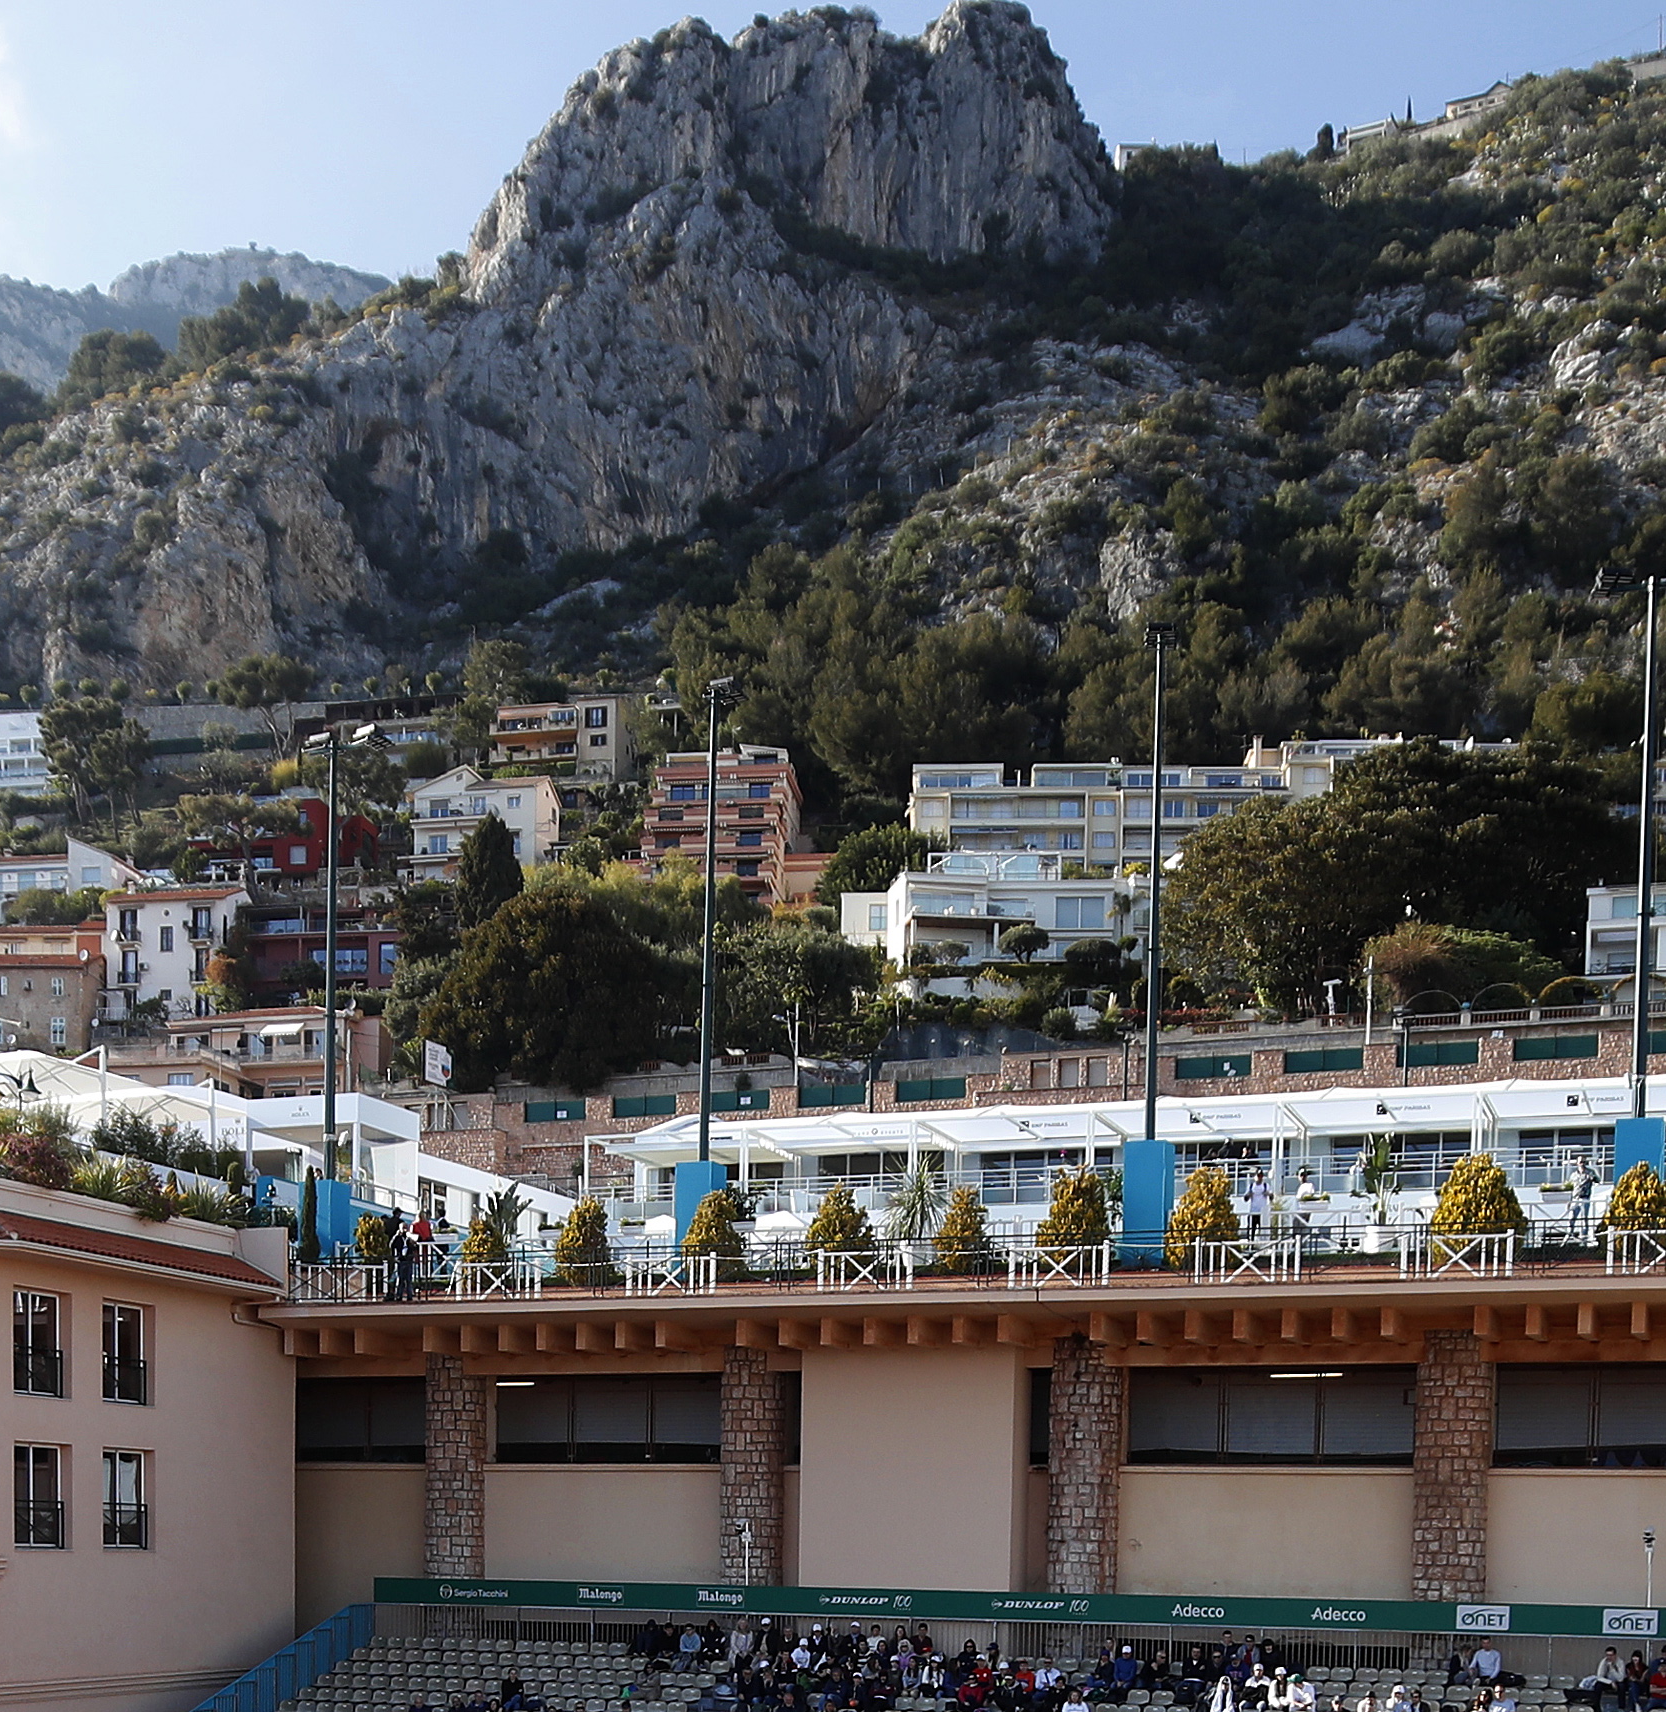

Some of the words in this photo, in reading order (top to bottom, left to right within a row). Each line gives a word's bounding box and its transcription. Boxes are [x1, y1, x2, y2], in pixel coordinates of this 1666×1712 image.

[579, 1588, 622, 1602] Malongo
[698, 1590, 743, 1604] Malongo
[830, 1596, 889, 1605] DUNLOP
[1003, 1600, 1065, 1609] DUNLOP
[1171, 1603, 1225, 1618] Adecco
[1311, 1607, 1366, 1622] Adecco
